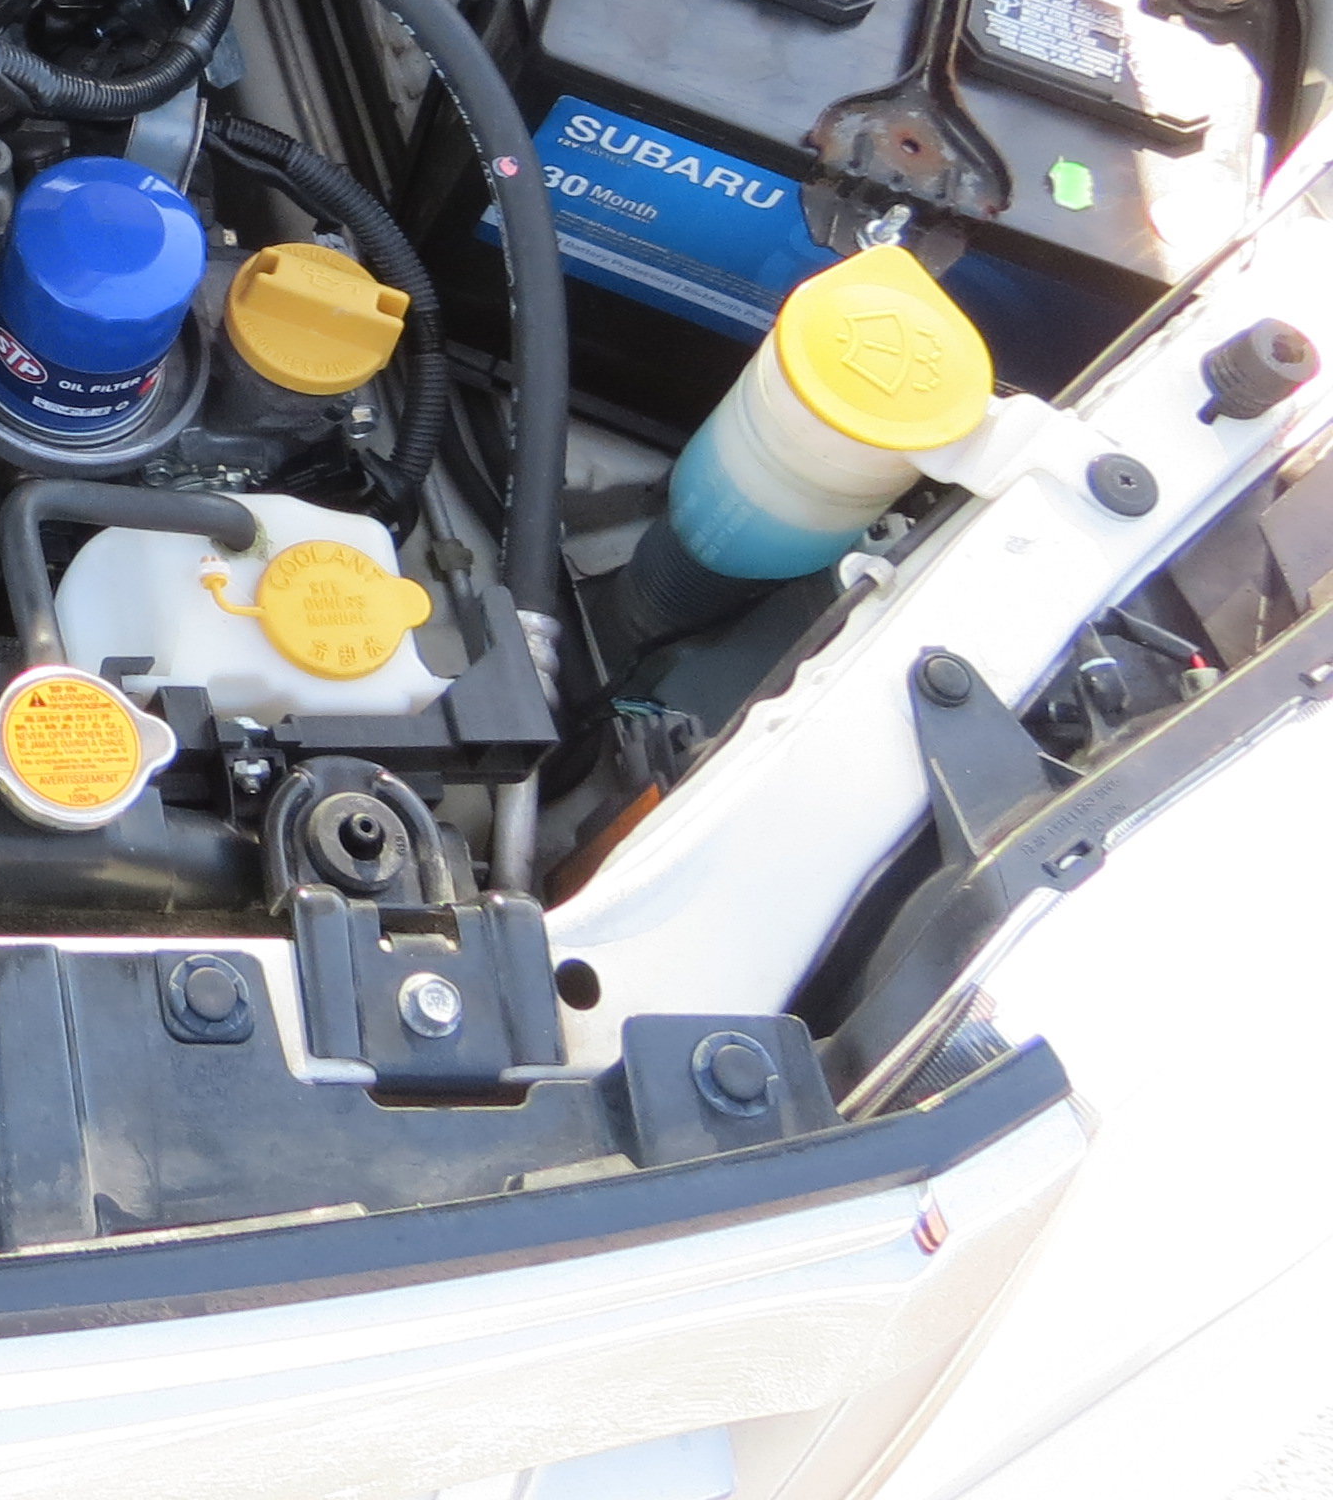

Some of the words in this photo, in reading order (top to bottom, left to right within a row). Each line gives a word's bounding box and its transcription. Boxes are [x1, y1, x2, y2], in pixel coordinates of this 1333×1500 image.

[556, 136, 581, 150] 12V
[564, 115, 785, 210] SUBARU
[541, 164, 590, 197] 30
[589, 184, 660, 220] Month
[58, 380, 85, 393] OIL
[89, 377, 142, 394] FILTER
[268, 545, 385, 591] COOLANT
[47, 693, 99, 701] WARNING
[39, 774, 118, 785] AVERTISSEMENT
